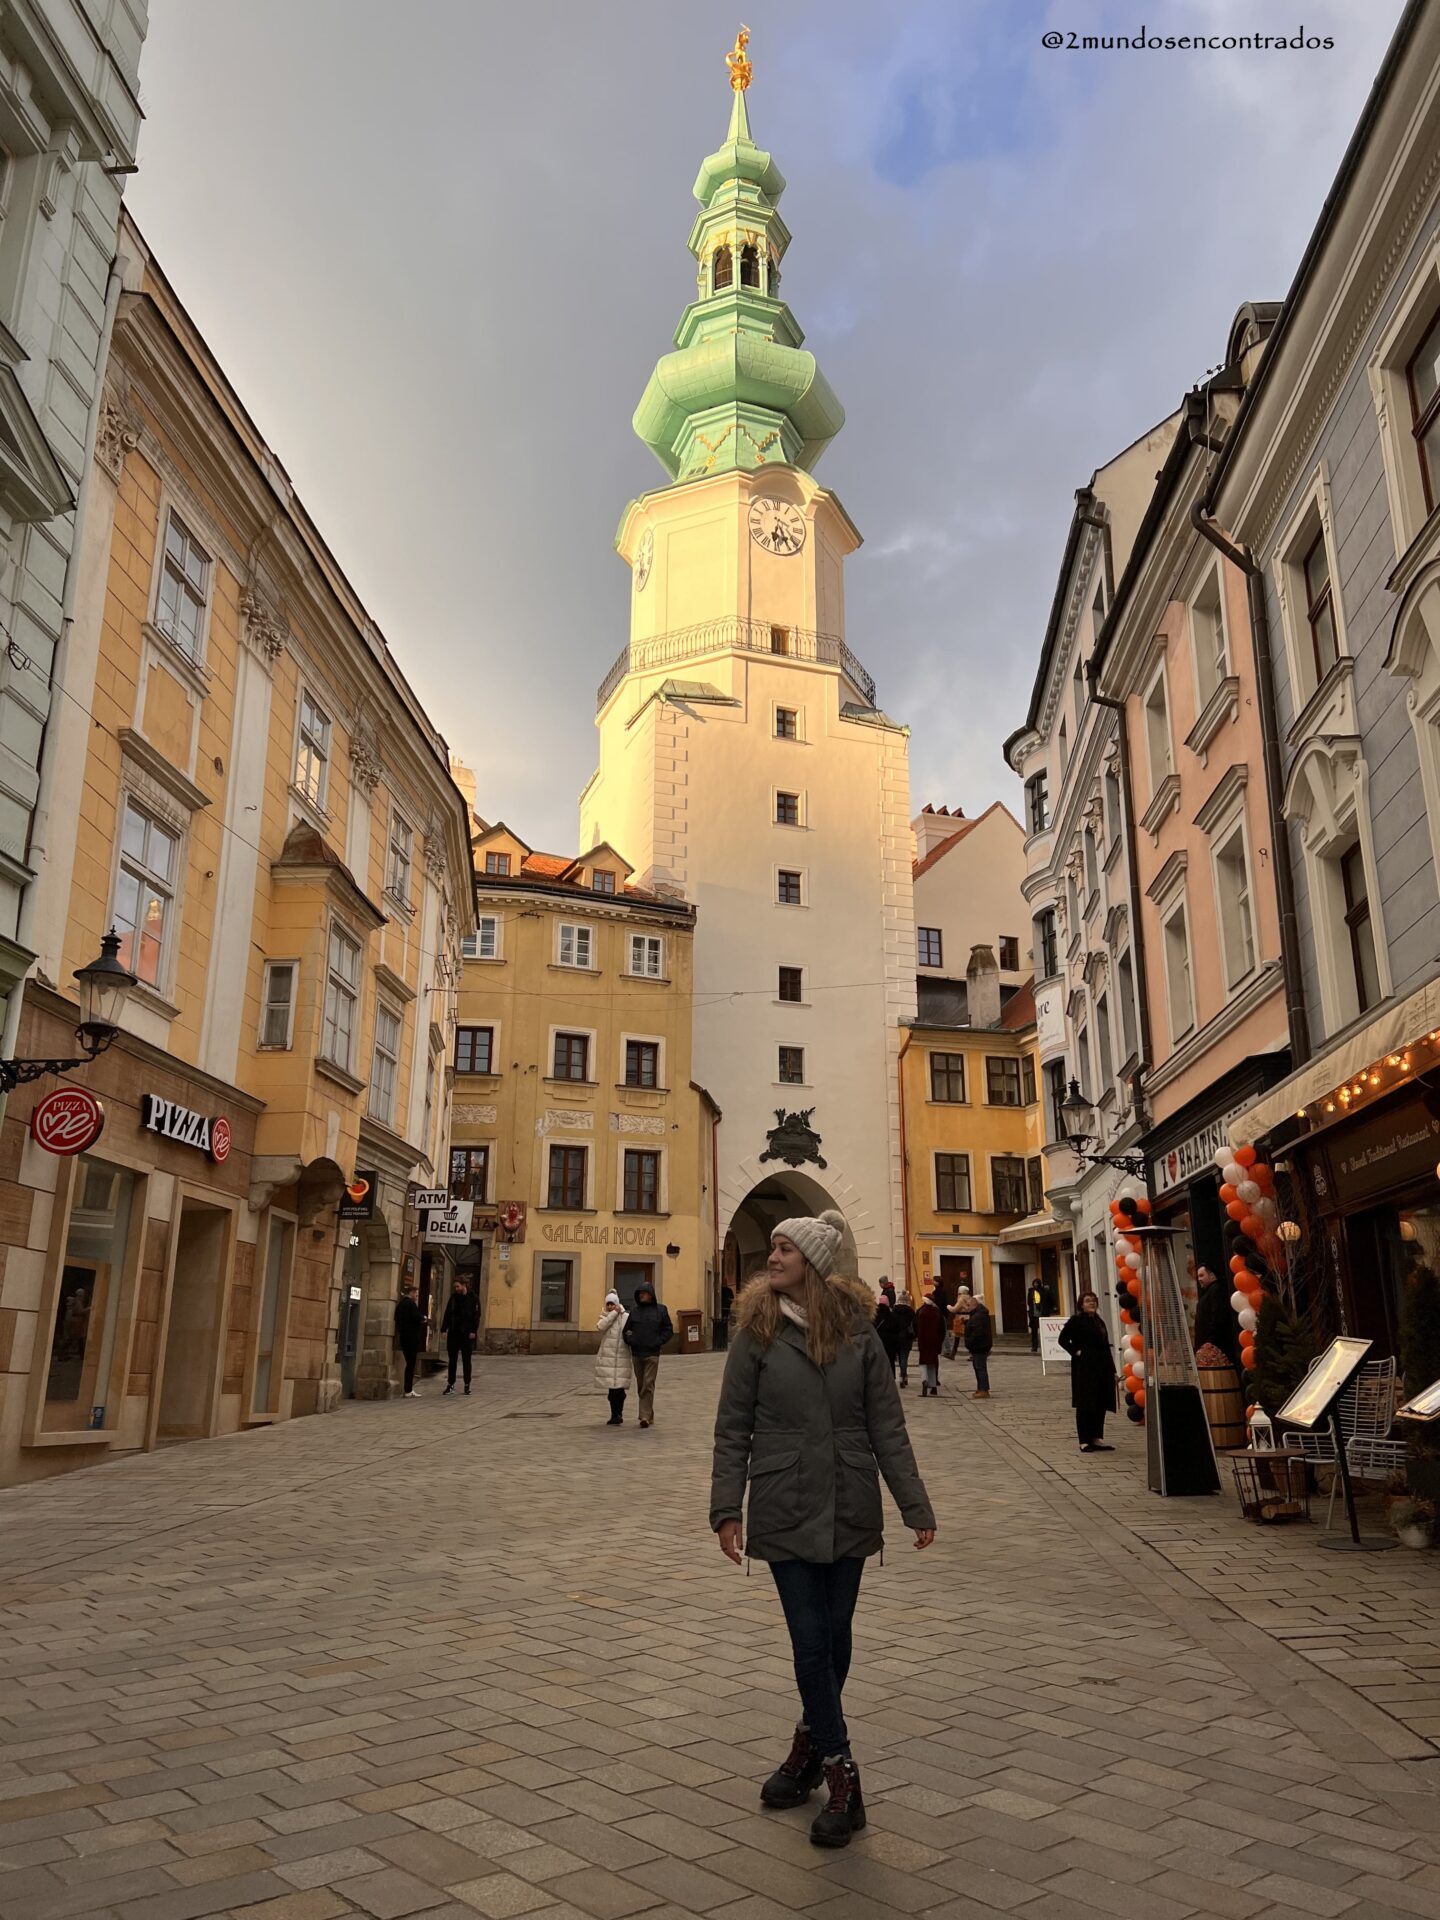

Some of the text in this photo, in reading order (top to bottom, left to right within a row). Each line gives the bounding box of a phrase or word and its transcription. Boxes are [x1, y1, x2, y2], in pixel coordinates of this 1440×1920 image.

[53, 1101, 87, 1112] PIZZA
[146, 1093, 210, 1151] PIZZA
[1161, 1158, 1168, 1189] I
[1178, 1103, 1248, 1179] BRATISL
[417, 1194, 446, 1204] ATM
[430, 1221, 467, 1234] DELIA
[541, 1221, 656, 1246] GALÉRIA NOVA
